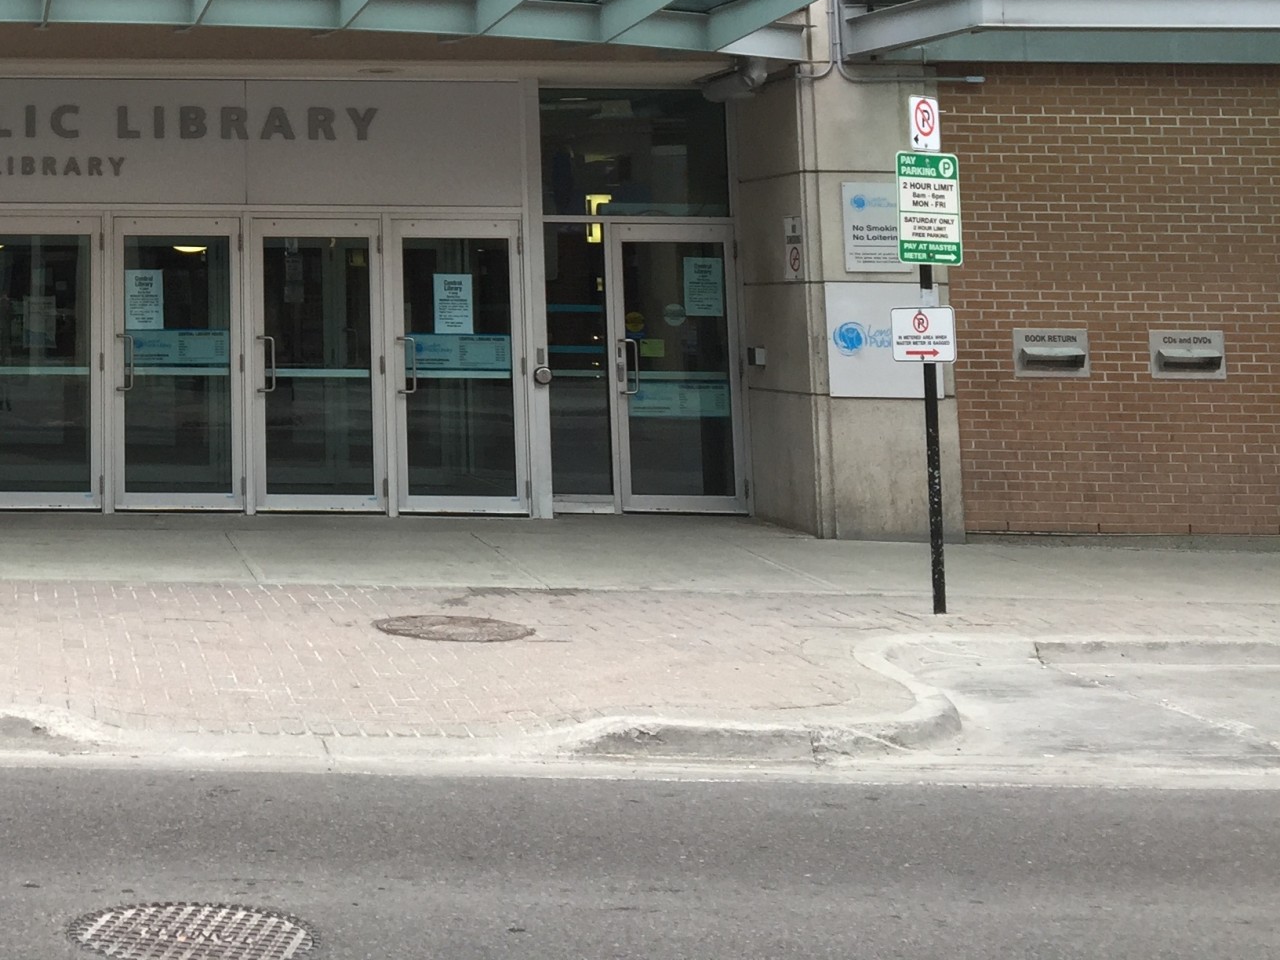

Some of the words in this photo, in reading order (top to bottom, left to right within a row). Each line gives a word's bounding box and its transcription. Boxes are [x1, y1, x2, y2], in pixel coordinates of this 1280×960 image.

[116, 105, 379, 141] LIBRARY
[901, 156, 916, 164] PAY
[901, 166, 937, 176] PARKING
[910, 182, 931, 190] HOUR
[934, 183, 953, 191] LIMIT
[904, 216, 937, 224] SATURDAY
[868, 324, 891, 337] Lon
[869, 337, 892, 348] Publ
[1163, 336, 1177, 344] CDs
[1193, 336, 1212, 344] DVDs
